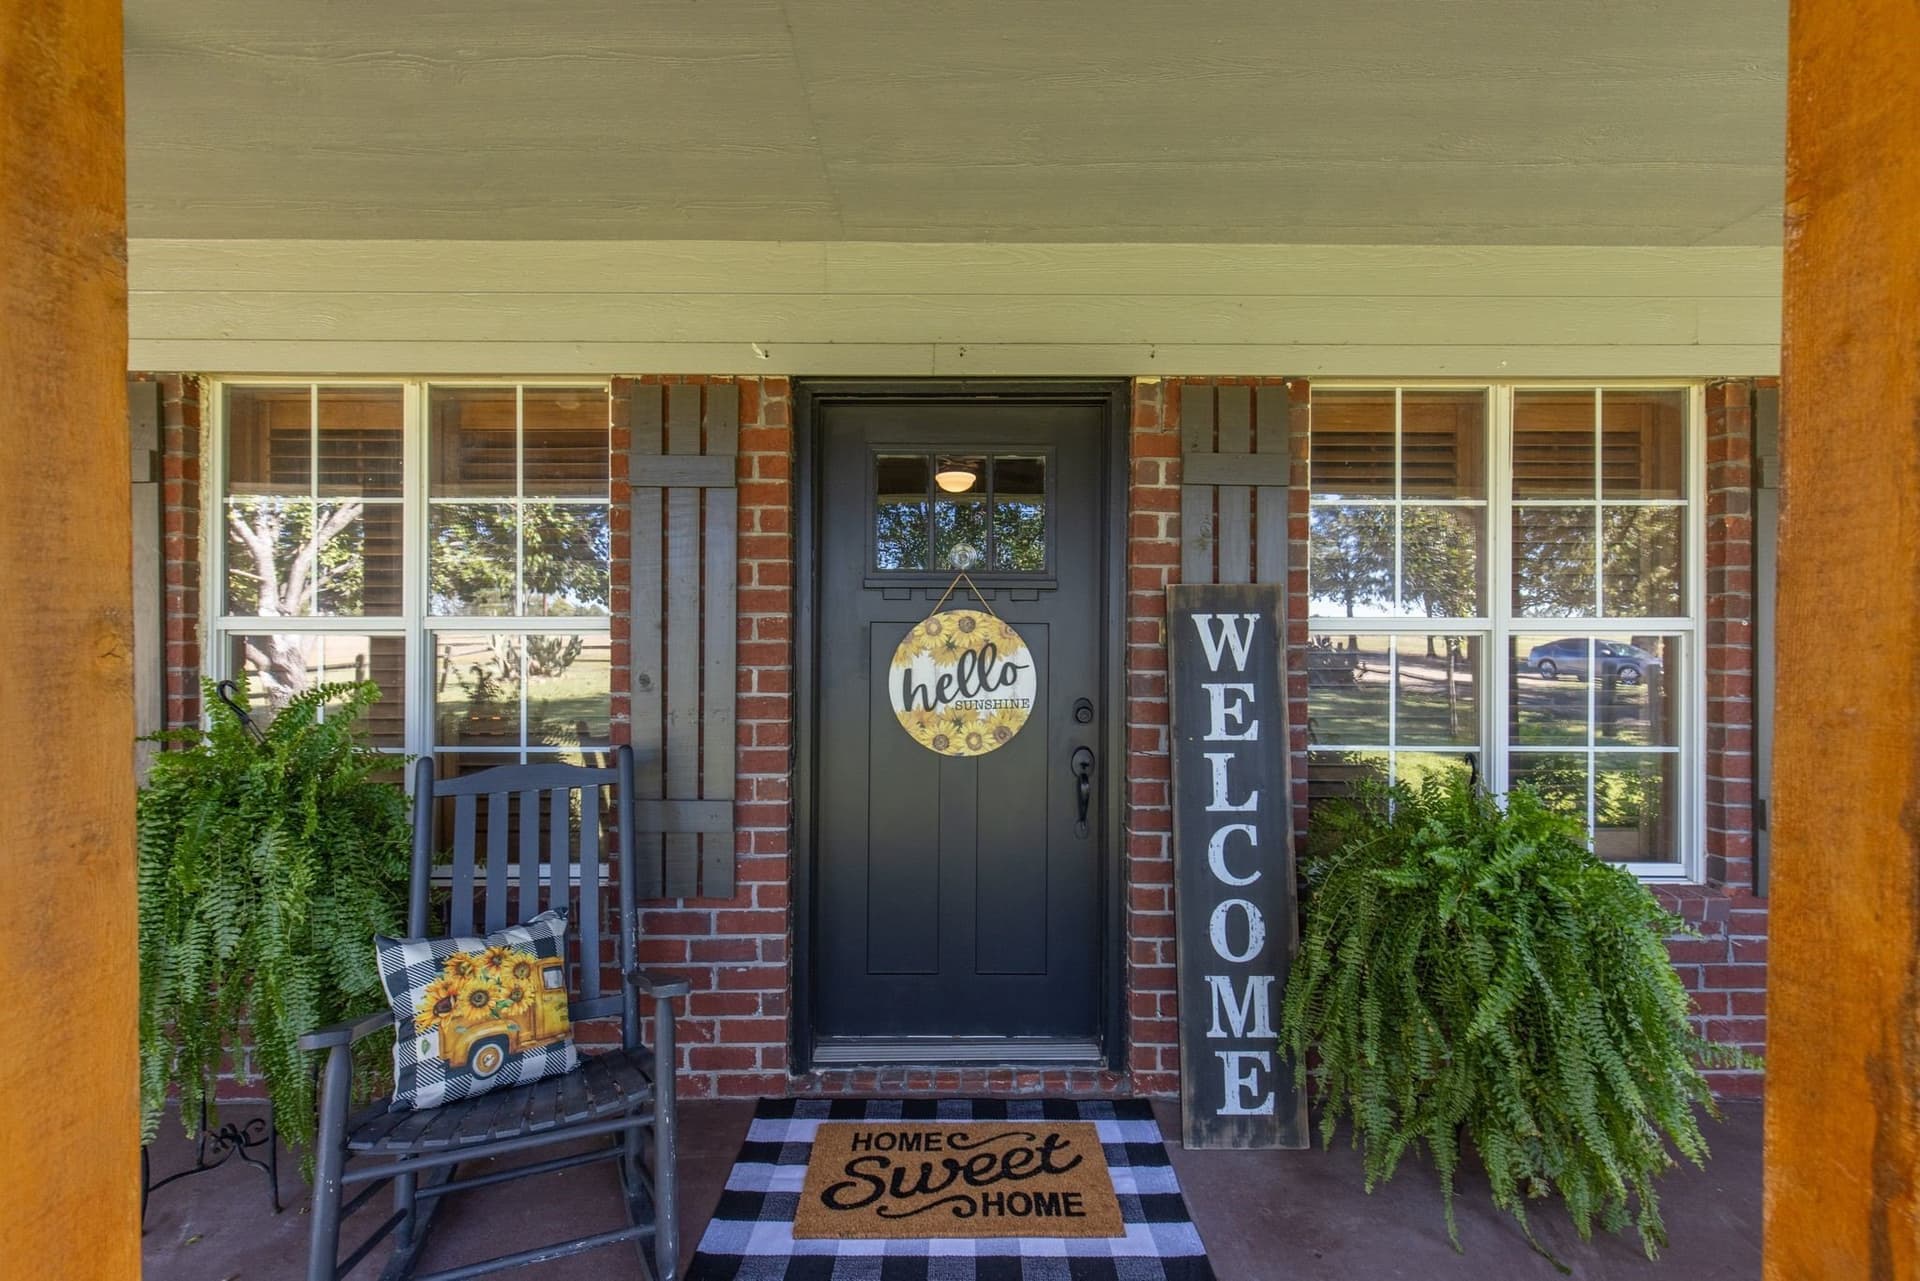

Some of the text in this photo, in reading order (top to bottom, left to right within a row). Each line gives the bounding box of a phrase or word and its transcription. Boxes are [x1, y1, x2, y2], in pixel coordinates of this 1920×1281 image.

[903, 642, 1030, 712] hello
[954, 698, 1030, 711] SUNSHINE
[1191, 613, 1277, 1116] WELCOME
[851, 1132, 943, 1152] HOME
[820, 1133, 1083, 1210] Sweet
[982, 1192, 1086, 1217] HOME
